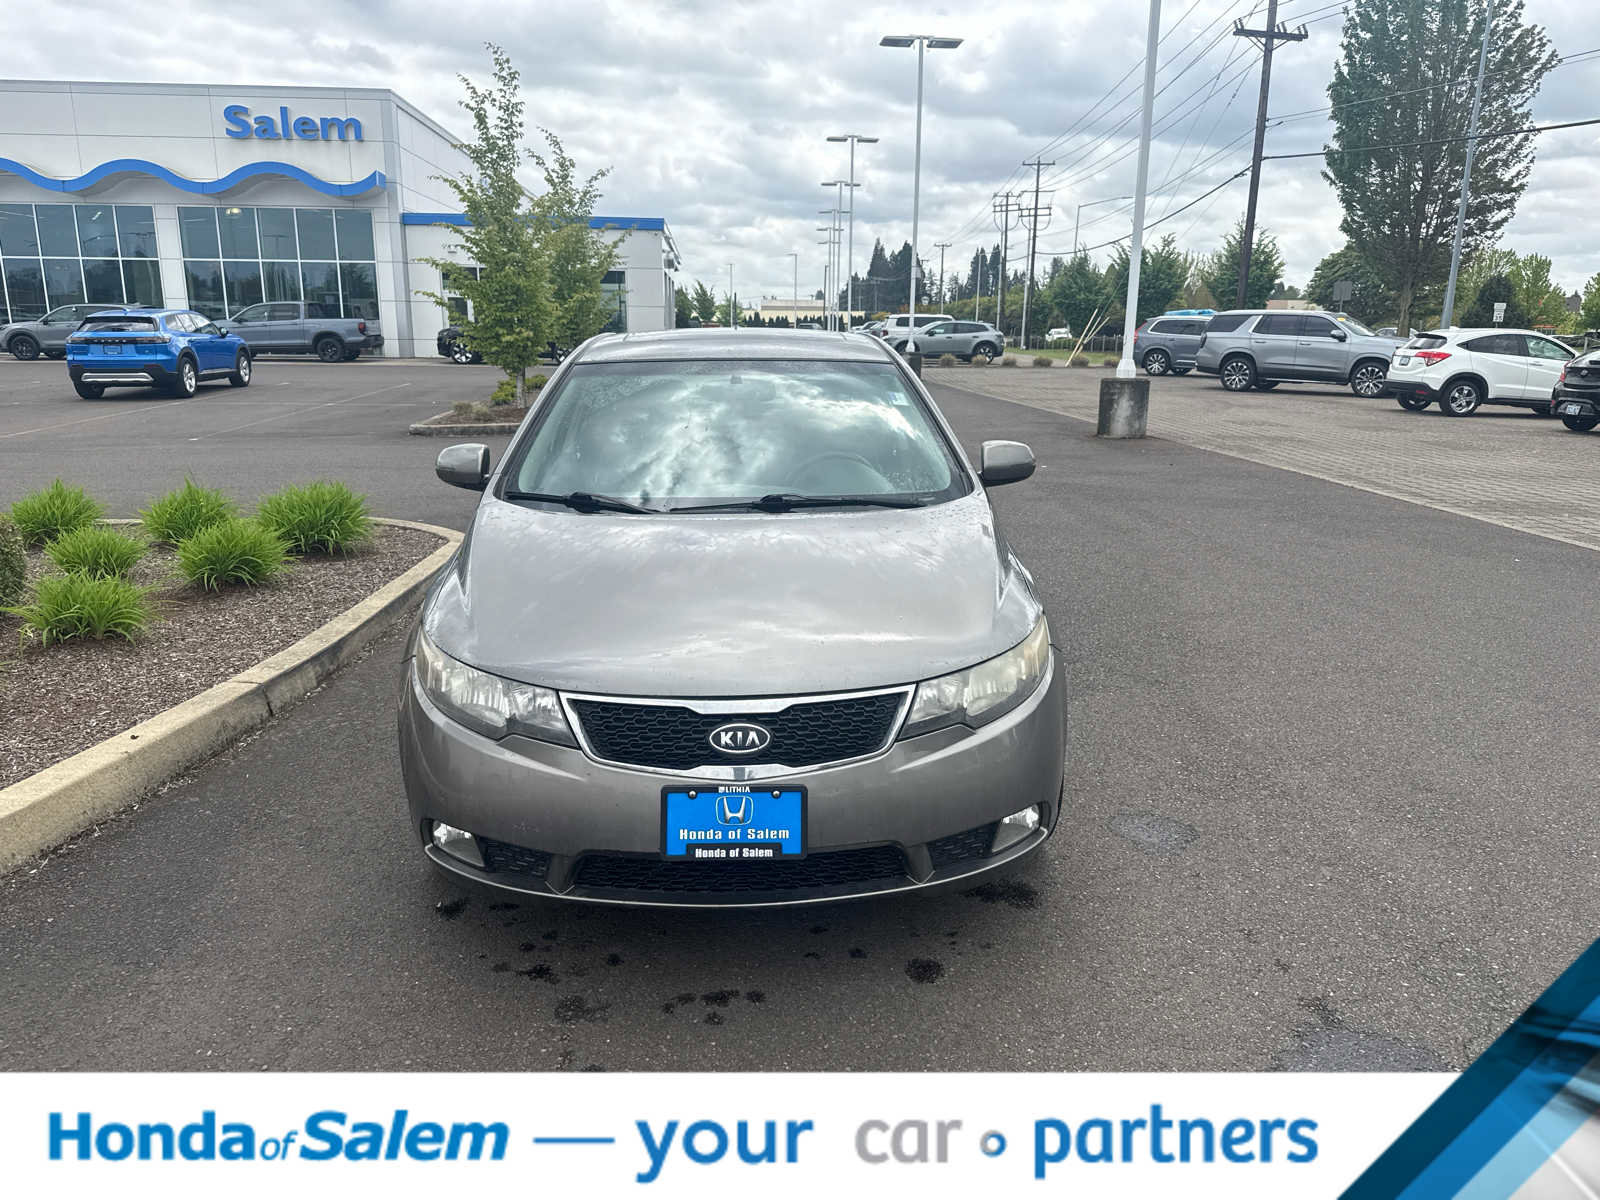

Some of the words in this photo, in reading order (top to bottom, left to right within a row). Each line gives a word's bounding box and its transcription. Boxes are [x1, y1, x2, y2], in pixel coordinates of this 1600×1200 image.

[223, 104, 364, 142] Salem
[720, 730, 760, 747] KIA
[679, 829, 722, 840] Honda
[728, 829, 742, 840] of
[747, 828, 790, 839] Salem
[695, 848, 726, 858] Honda
[729, 848, 740, 858] of
[742, 848, 773, 857] Salem
